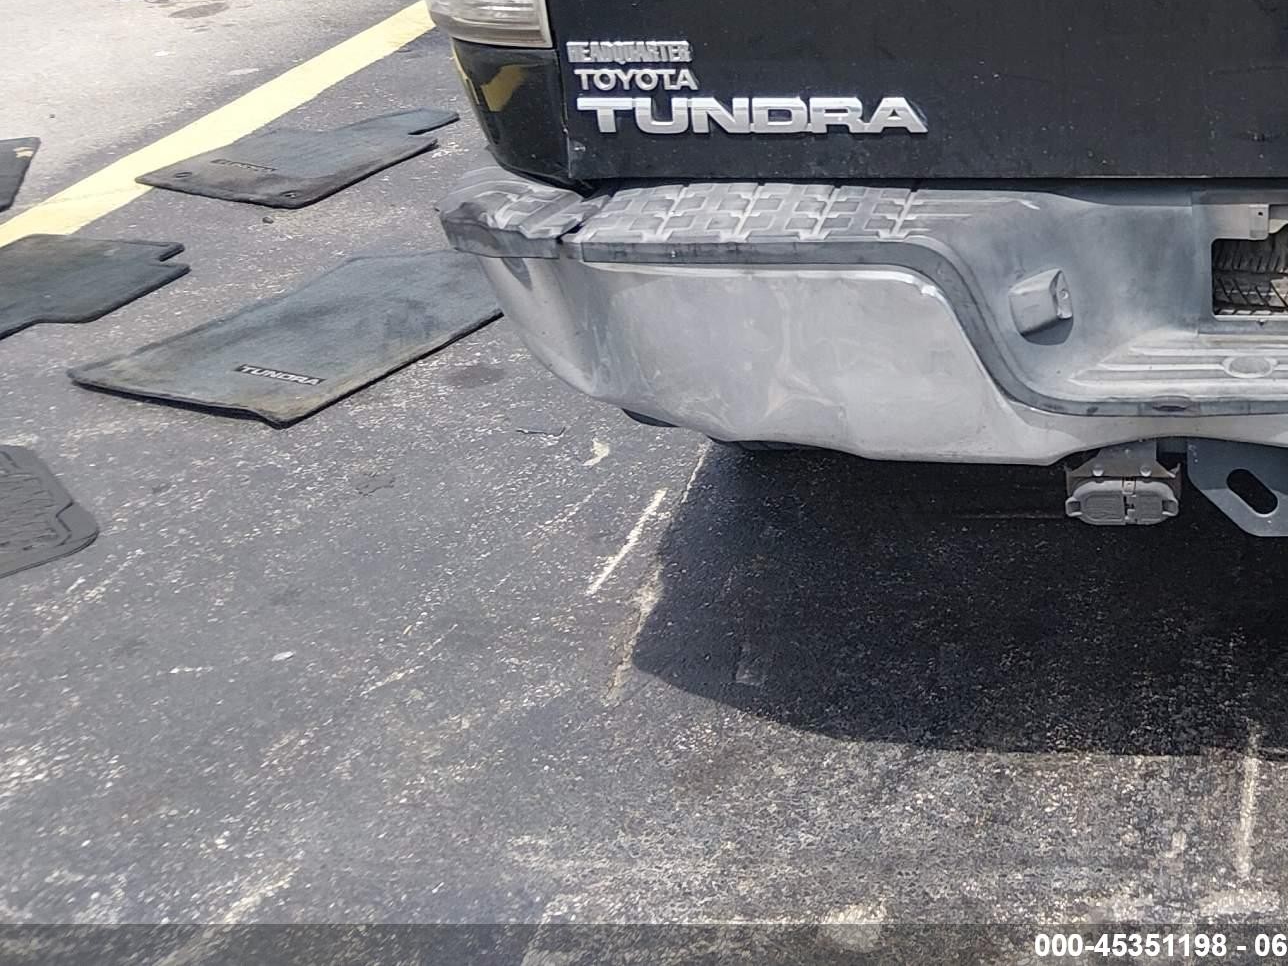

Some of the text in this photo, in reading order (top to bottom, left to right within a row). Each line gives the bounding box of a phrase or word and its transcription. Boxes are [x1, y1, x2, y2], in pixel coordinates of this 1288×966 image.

[574, 69, 698, 90] TOYOTA
[577, 97, 928, 133] TUNDRA
[241, 365, 320, 385] TUNDRA
